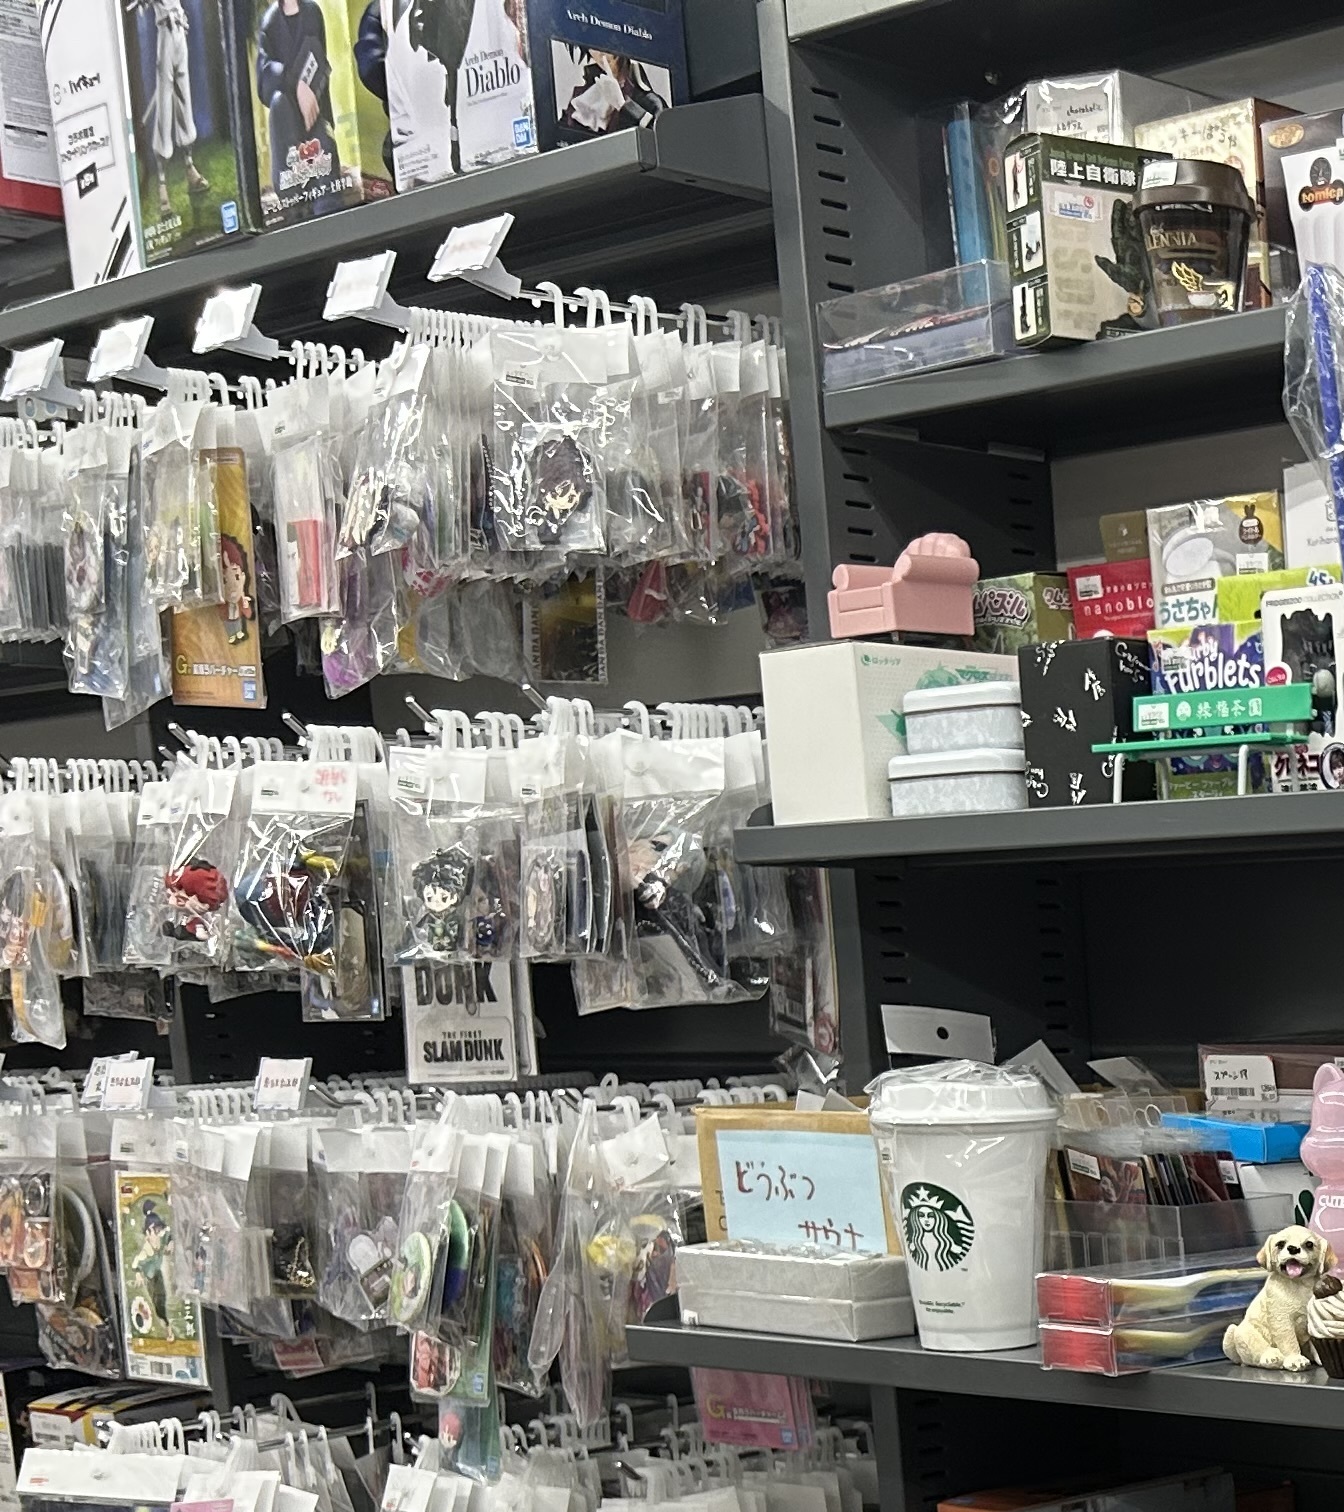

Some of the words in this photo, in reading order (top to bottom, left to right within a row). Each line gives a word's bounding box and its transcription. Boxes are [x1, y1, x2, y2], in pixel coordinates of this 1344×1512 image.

[465, 58, 521, 98] Diablo
[1050, 157, 1136, 187] 陸上自衛隊
